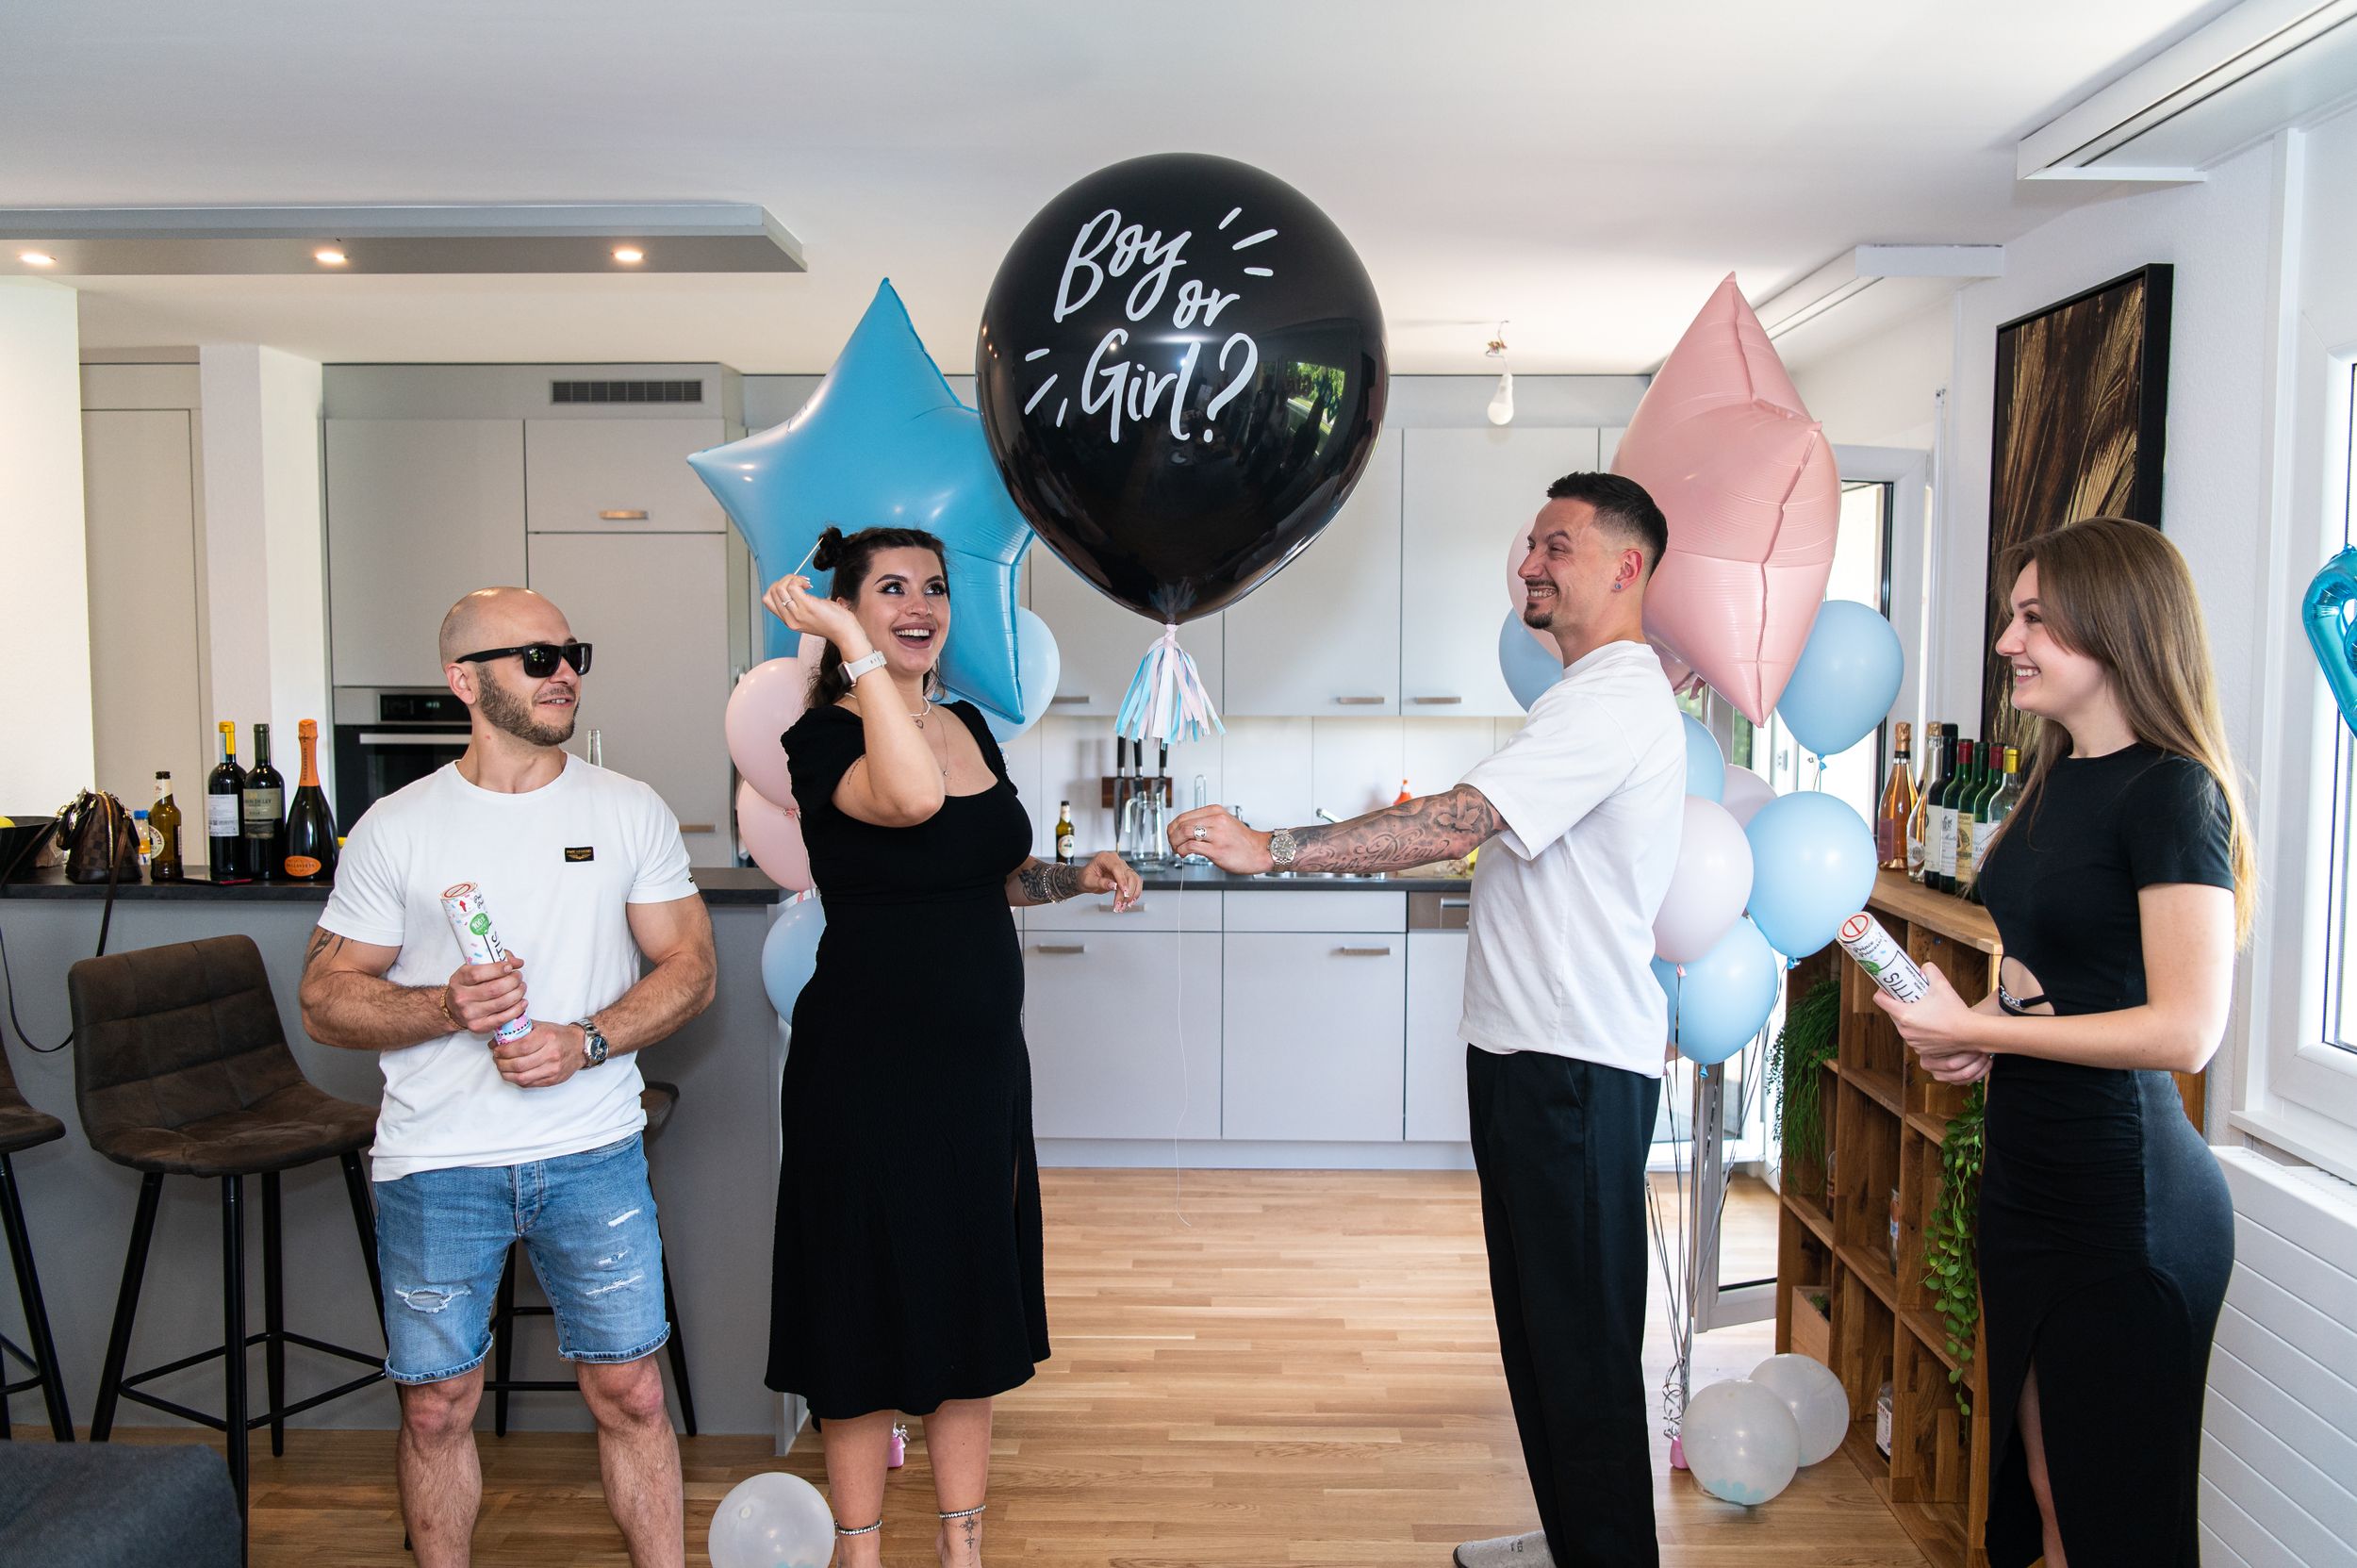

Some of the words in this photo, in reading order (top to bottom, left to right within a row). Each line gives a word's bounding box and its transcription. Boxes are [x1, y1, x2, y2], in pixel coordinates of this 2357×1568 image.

[1053, 208, 1192, 322] Boy
[1172, 279, 1240, 329] or
[1081, 327, 1258, 443] Girl?
